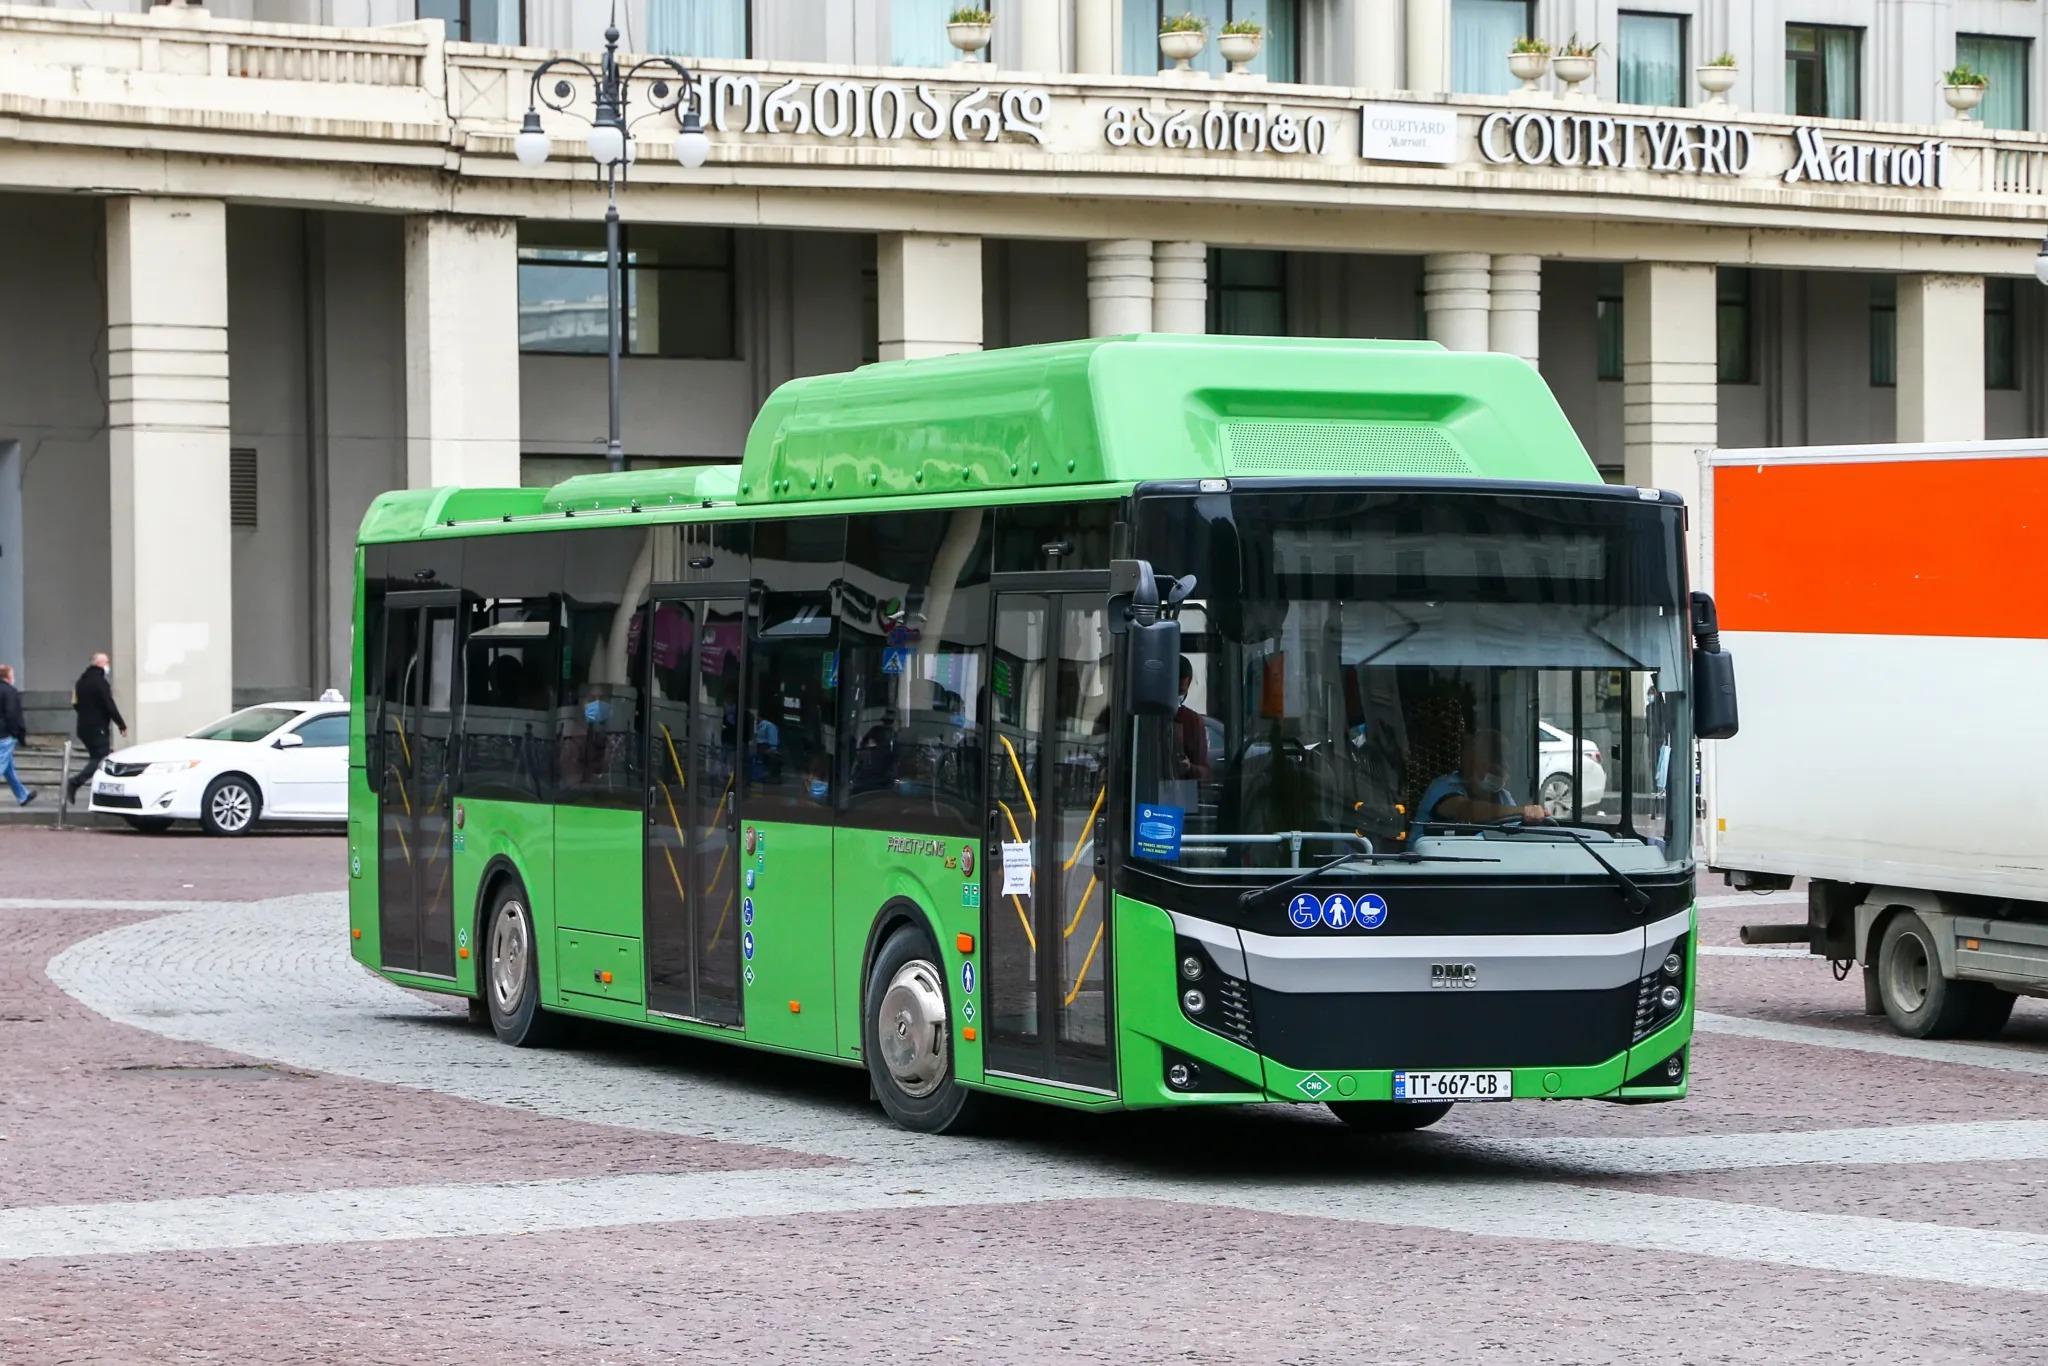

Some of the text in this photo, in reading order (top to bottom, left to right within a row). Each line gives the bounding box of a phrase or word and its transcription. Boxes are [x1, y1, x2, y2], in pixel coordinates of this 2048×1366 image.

[1104, 105, 1330, 154] მარიოტი
[1371, 118, 1446, 135] COURTYARD
[1479, 112, 1755, 174] COURTYARD
[1431, 963, 1477, 988] BMC
[1306, 1081, 1321, 1090] CNG
[1395, 1074, 1498, 1096] GE TT-667-CB
